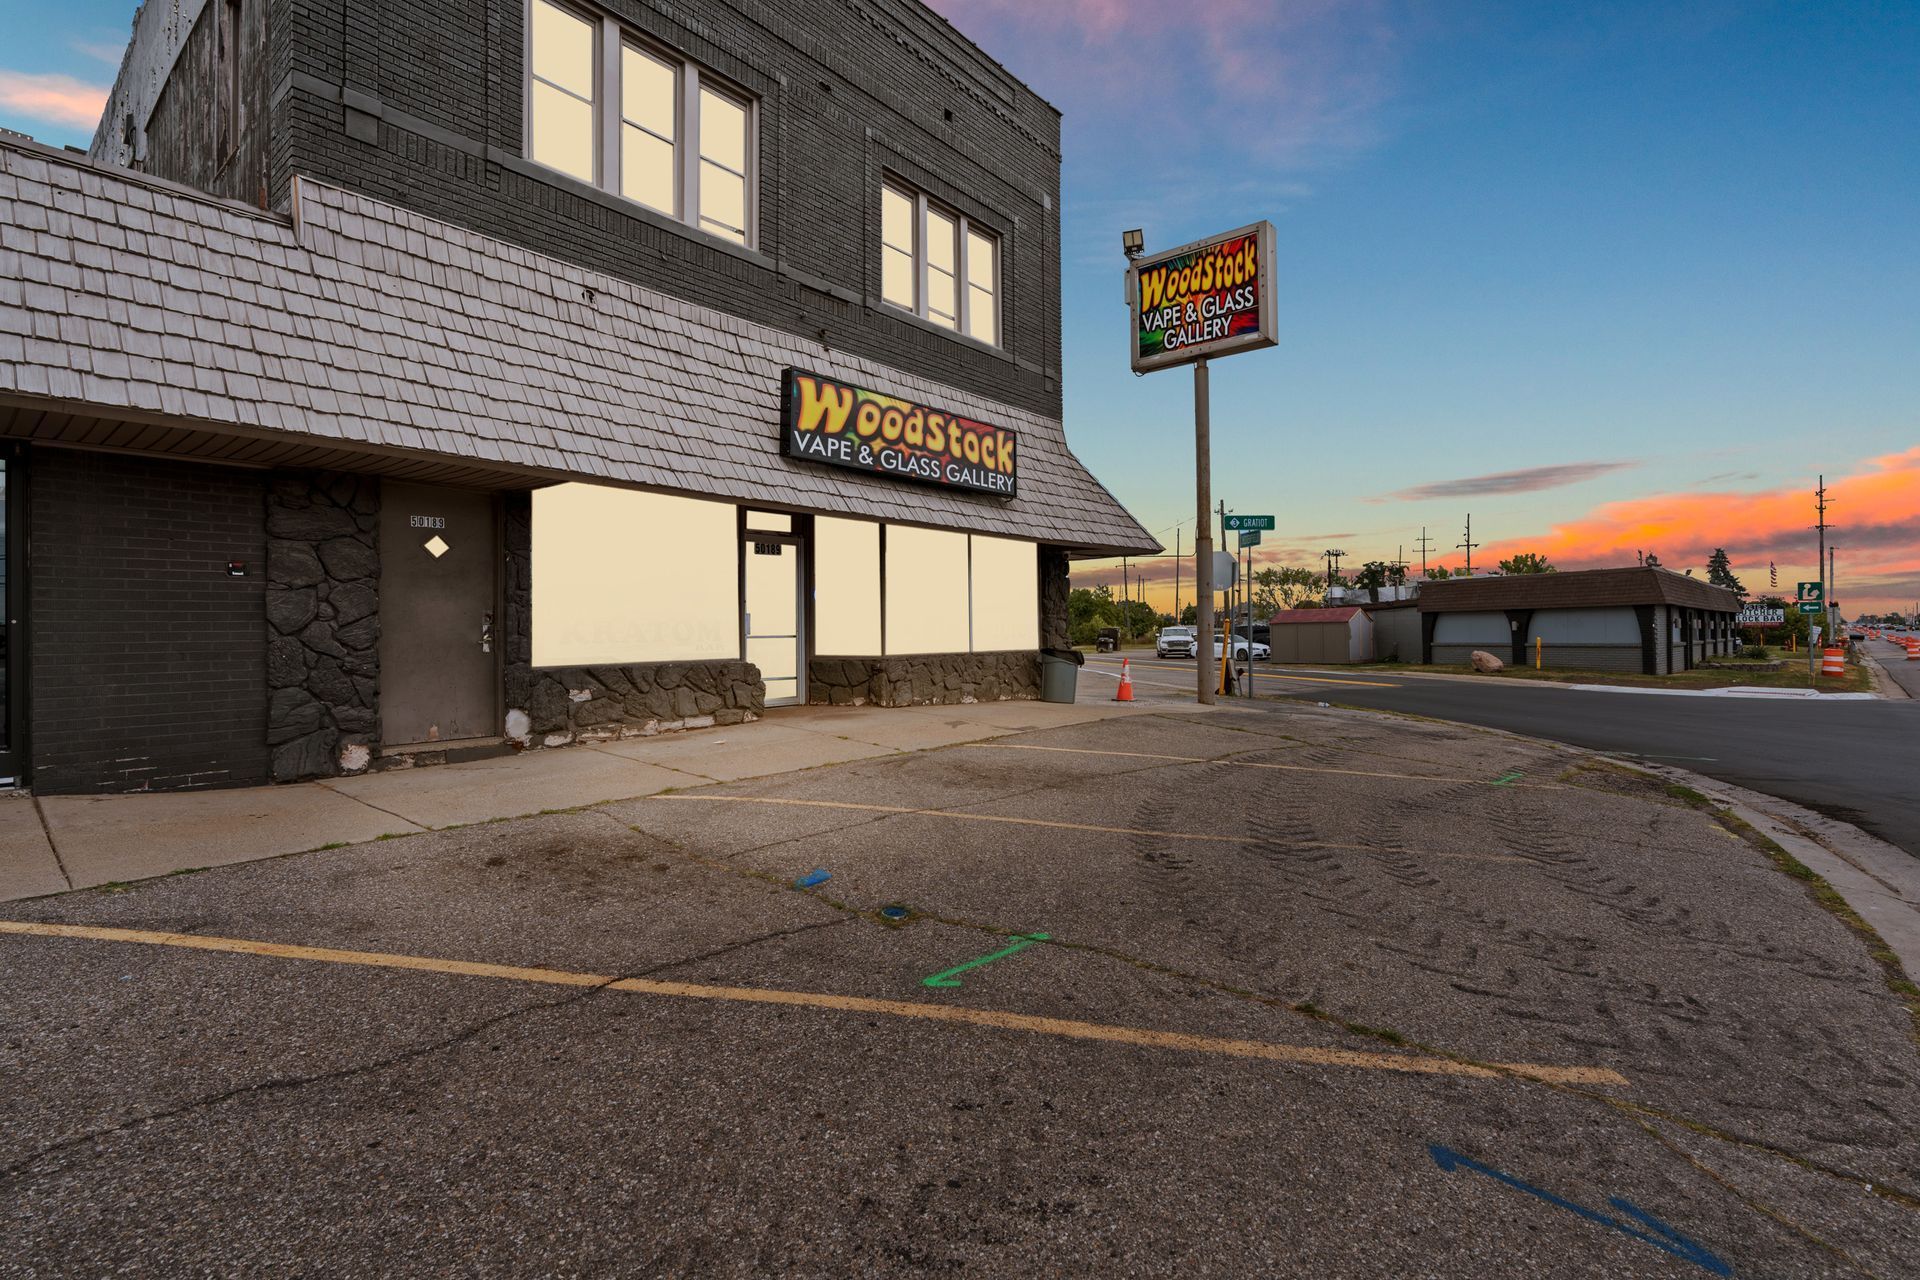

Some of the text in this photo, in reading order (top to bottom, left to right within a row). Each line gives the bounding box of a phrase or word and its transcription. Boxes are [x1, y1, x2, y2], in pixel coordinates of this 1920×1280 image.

[1142, 286, 1254, 332] VAPE & GLASS
[1164, 315, 1233, 349] GALLERY
[794, 430, 1014, 492] VAPE & GLASS GALLERY
[411, 516, 444, 528] 50189
[1243, 518, 1268, 527] GRATIOT
[755, 543, 780, 555] 50189
